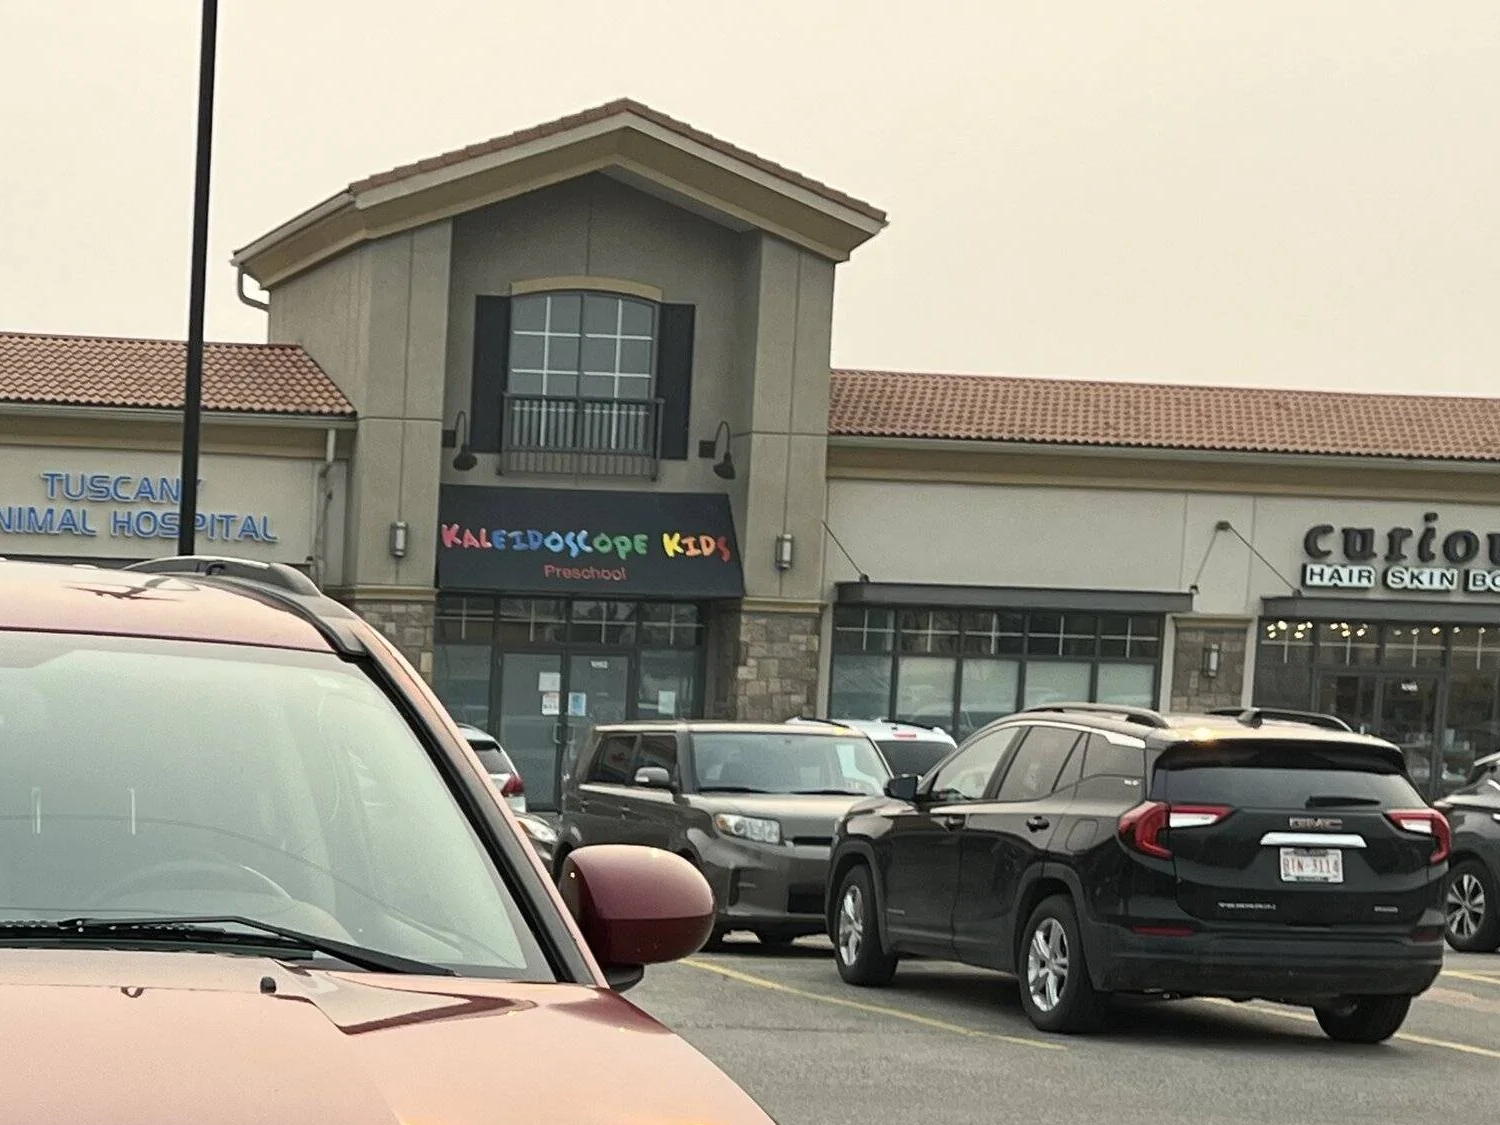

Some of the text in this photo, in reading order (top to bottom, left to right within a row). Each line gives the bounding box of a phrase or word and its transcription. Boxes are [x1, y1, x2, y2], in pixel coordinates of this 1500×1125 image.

[42, 472, 203, 504] TUSCAN
[441, 523, 731, 563] KALEIDOSCOPE KIDS
[543, 563, 629, 582] Preschool
[1307, 566, 1374, 585] HAIR
[1389, 567, 1456, 588] SKIN
[1288, 816, 1344, 832] GMC
